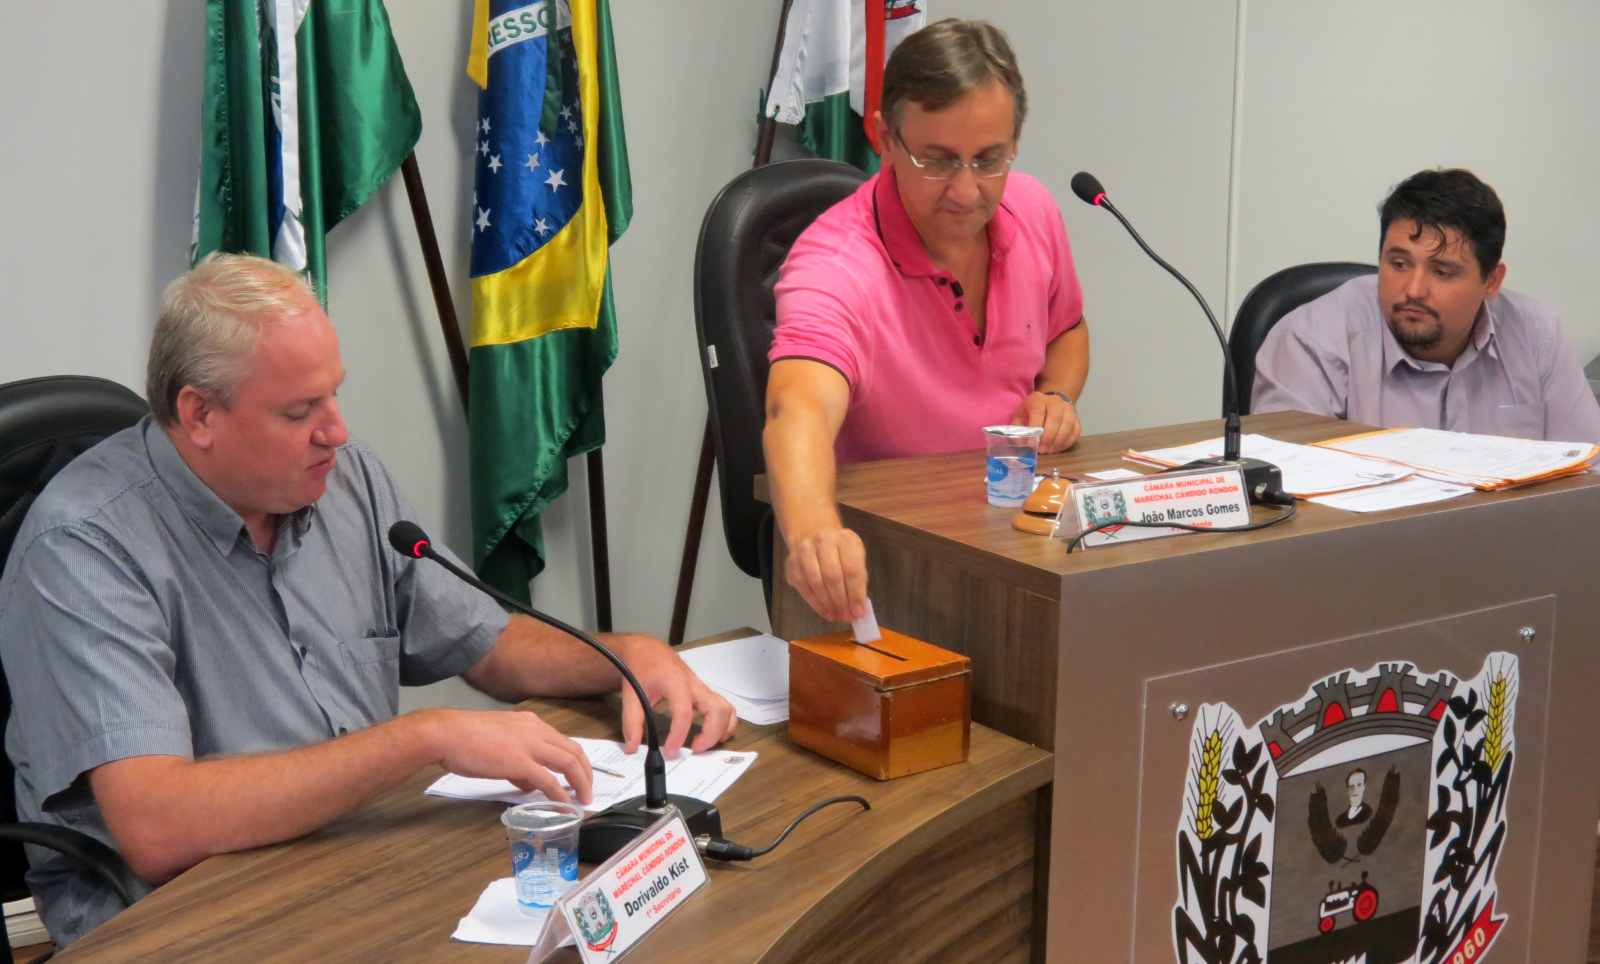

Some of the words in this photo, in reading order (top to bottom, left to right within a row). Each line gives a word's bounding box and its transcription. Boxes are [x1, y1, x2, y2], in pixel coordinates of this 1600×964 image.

[1134, 494, 1174, 504] MARECHAL
[1175, 489, 1207, 499] CÂNDIDO
[1209, 485, 1239, 495] RONDON
[1143, 482, 1174, 492] CÂMARA
[1176, 478, 1214, 488] MUNICIPAL
[1216, 476, 1226, 484] DE
[1140, 511, 1165, 523] João
[1166, 507, 1204, 521] Marcos
[1206, 503, 1240, 516] Gomes
[613, 872, 643, 899] MARECHAL
[642, 853, 665, 876] CÂNDIDO
[664, 836, 686, 858] RONDON
[615, 858, 639, 879] CÂMARA
[638, 837, 666, 862] MUNICIPAL
[665, 830, 674, 840] DE
[624, 876, 670, 918] Dorivaldo
[668, 856, 690, 881] Kist
[652, 887, 682, 914] Secretário
[1446, 928, 1485, 964] 960
